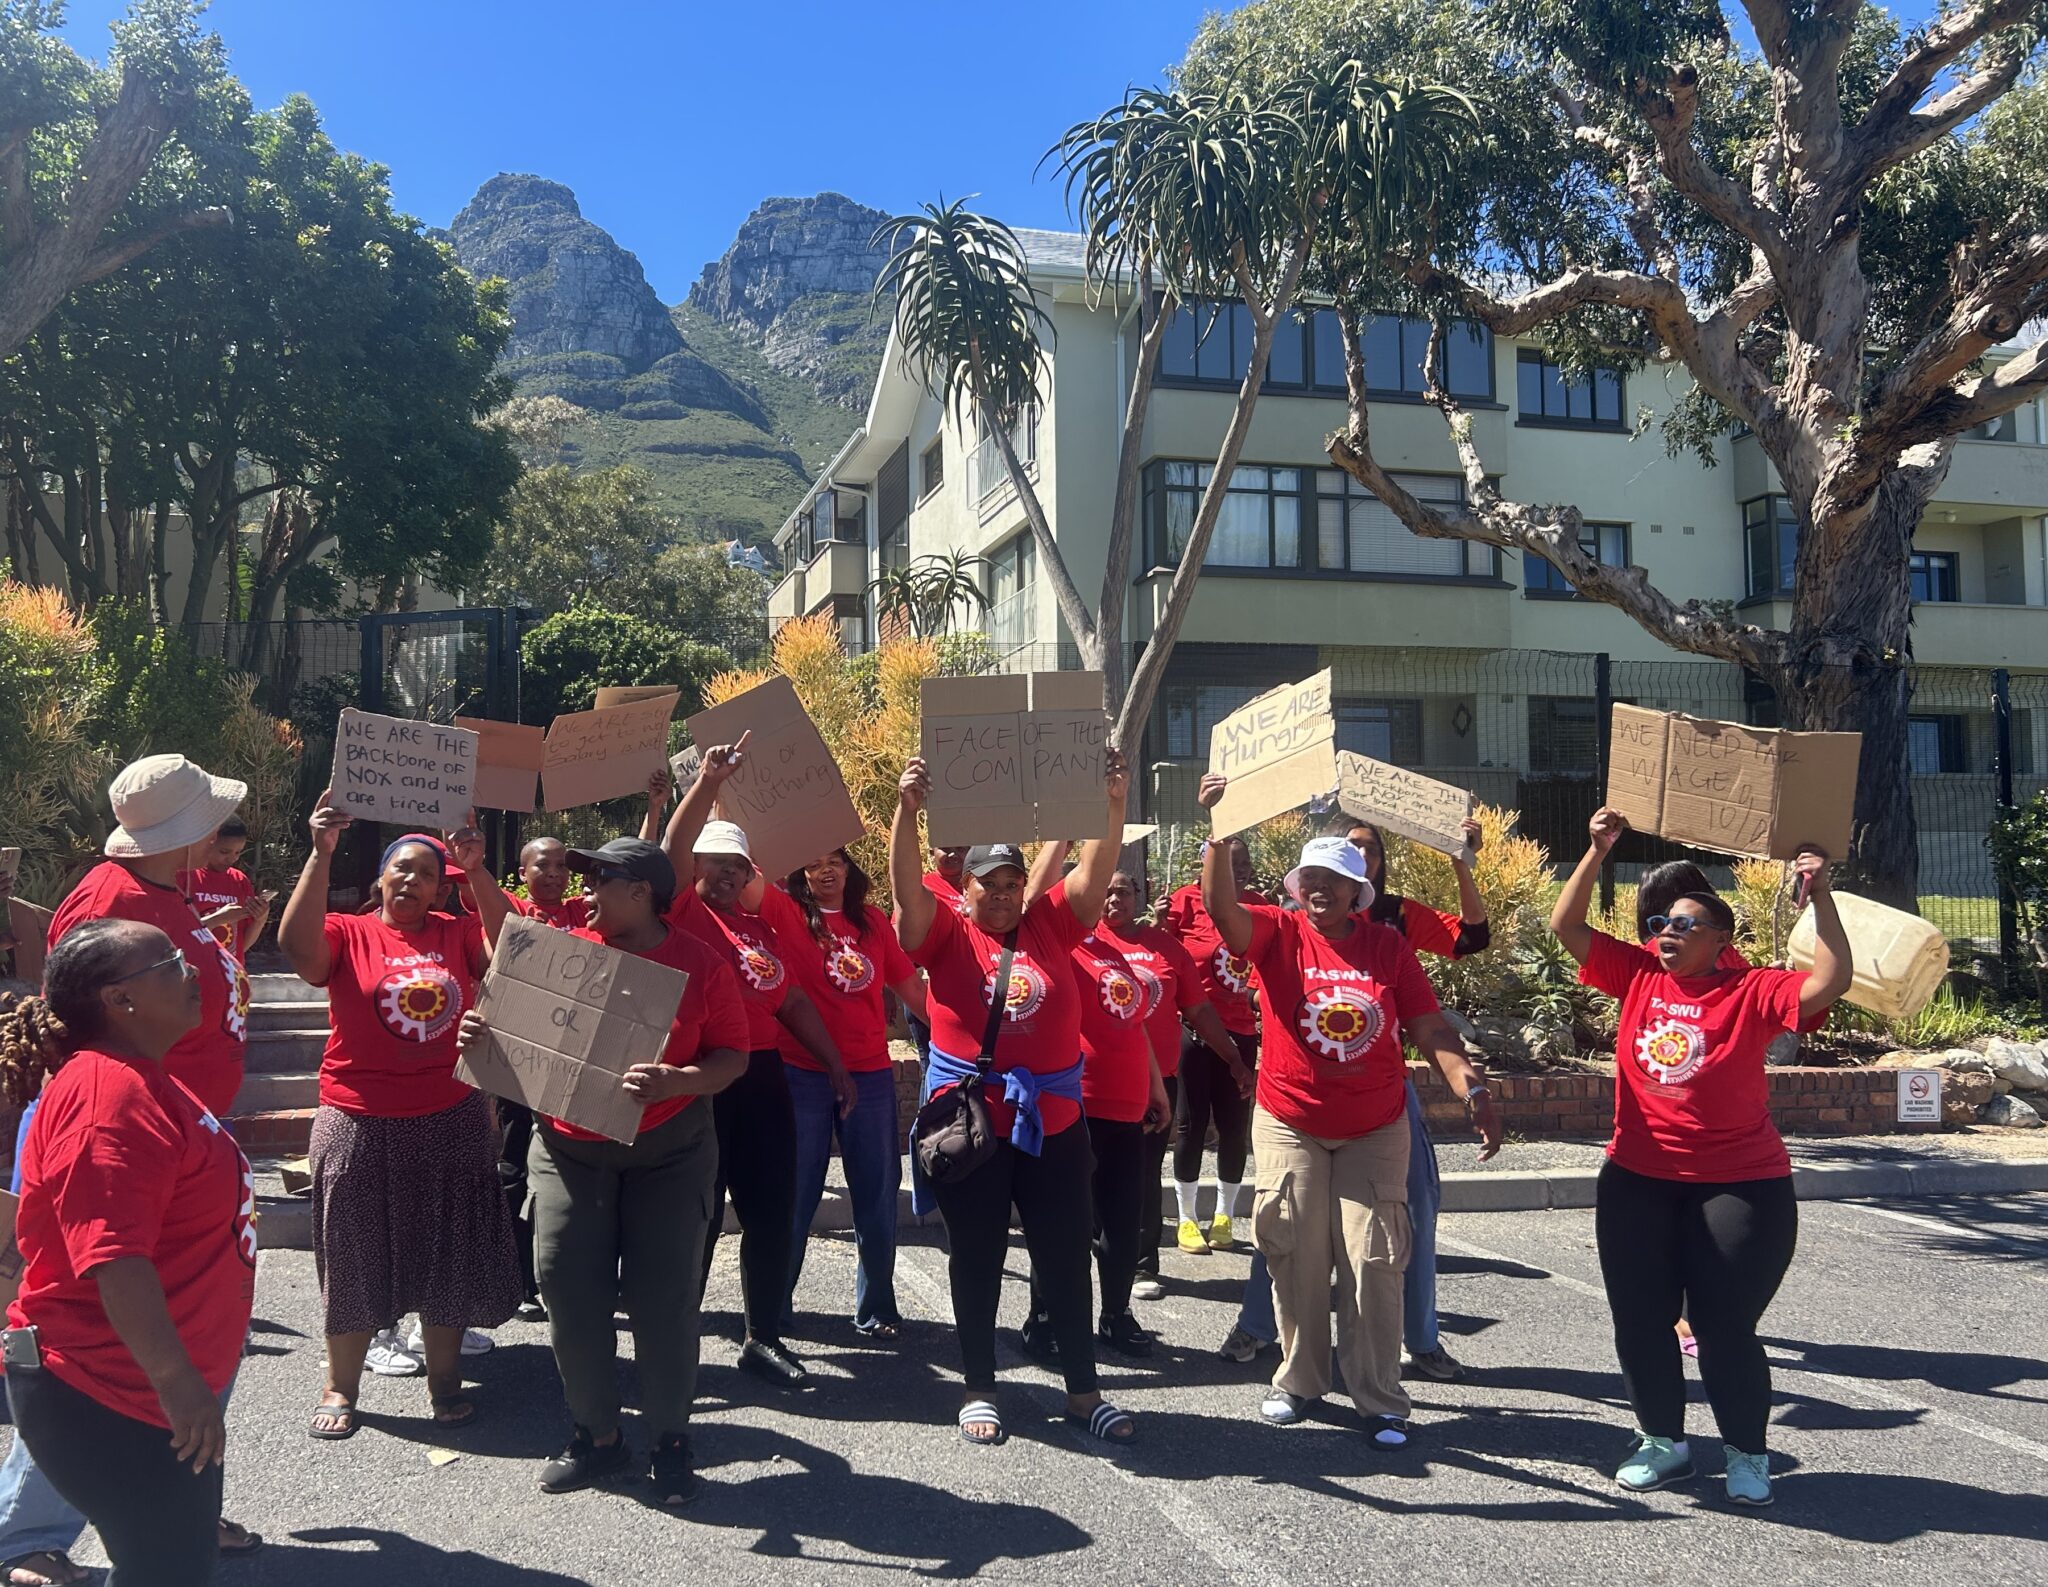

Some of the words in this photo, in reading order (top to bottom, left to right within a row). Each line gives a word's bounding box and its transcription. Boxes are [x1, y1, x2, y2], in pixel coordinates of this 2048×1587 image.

[1226, 705, 1278, 742] WE
[1281, 686, 1325, 724] ARE
[345, 722, 375, 740] WE
[387, 726, 422, 745] ARE
[434, 733, 470, 757] THE
[935, 727, 1016, 756] FACE
[1024, 722, 1057, 745] OF
[1067, 720, 1104, 745] THE
[1220, 725, 1315, 770] Hungry
[1620, 719, 1655, 746] WE
[1672, 730, 1741, 759] NEED
[677, 755, 701, 775] We
[779, 743, 798, 764] or
[346, 766, 392, 786] NOX
[401, 776, 439, 791] and
[446, 784, 467, 796] we
[736, 763, 834, 821] Nothing
[1349, 755, 1386, 778] WE
[1390, 772, 1427, 791] ARE
[1434, 786, 1466, 804] THE
[346, 791, 375, 806] are
[391, 795, 440, 814] tired
[195, 892, 238, 904] TASWU
[1123, 952, 1154, 962] SWU
[1304, 967, 1370, 981] TASWU
[551, 1006, 579, 1032] OR
[1650, 997, 1702, 1019] TASWU
[1346, 1041, 1373, 1061] SERVICES
